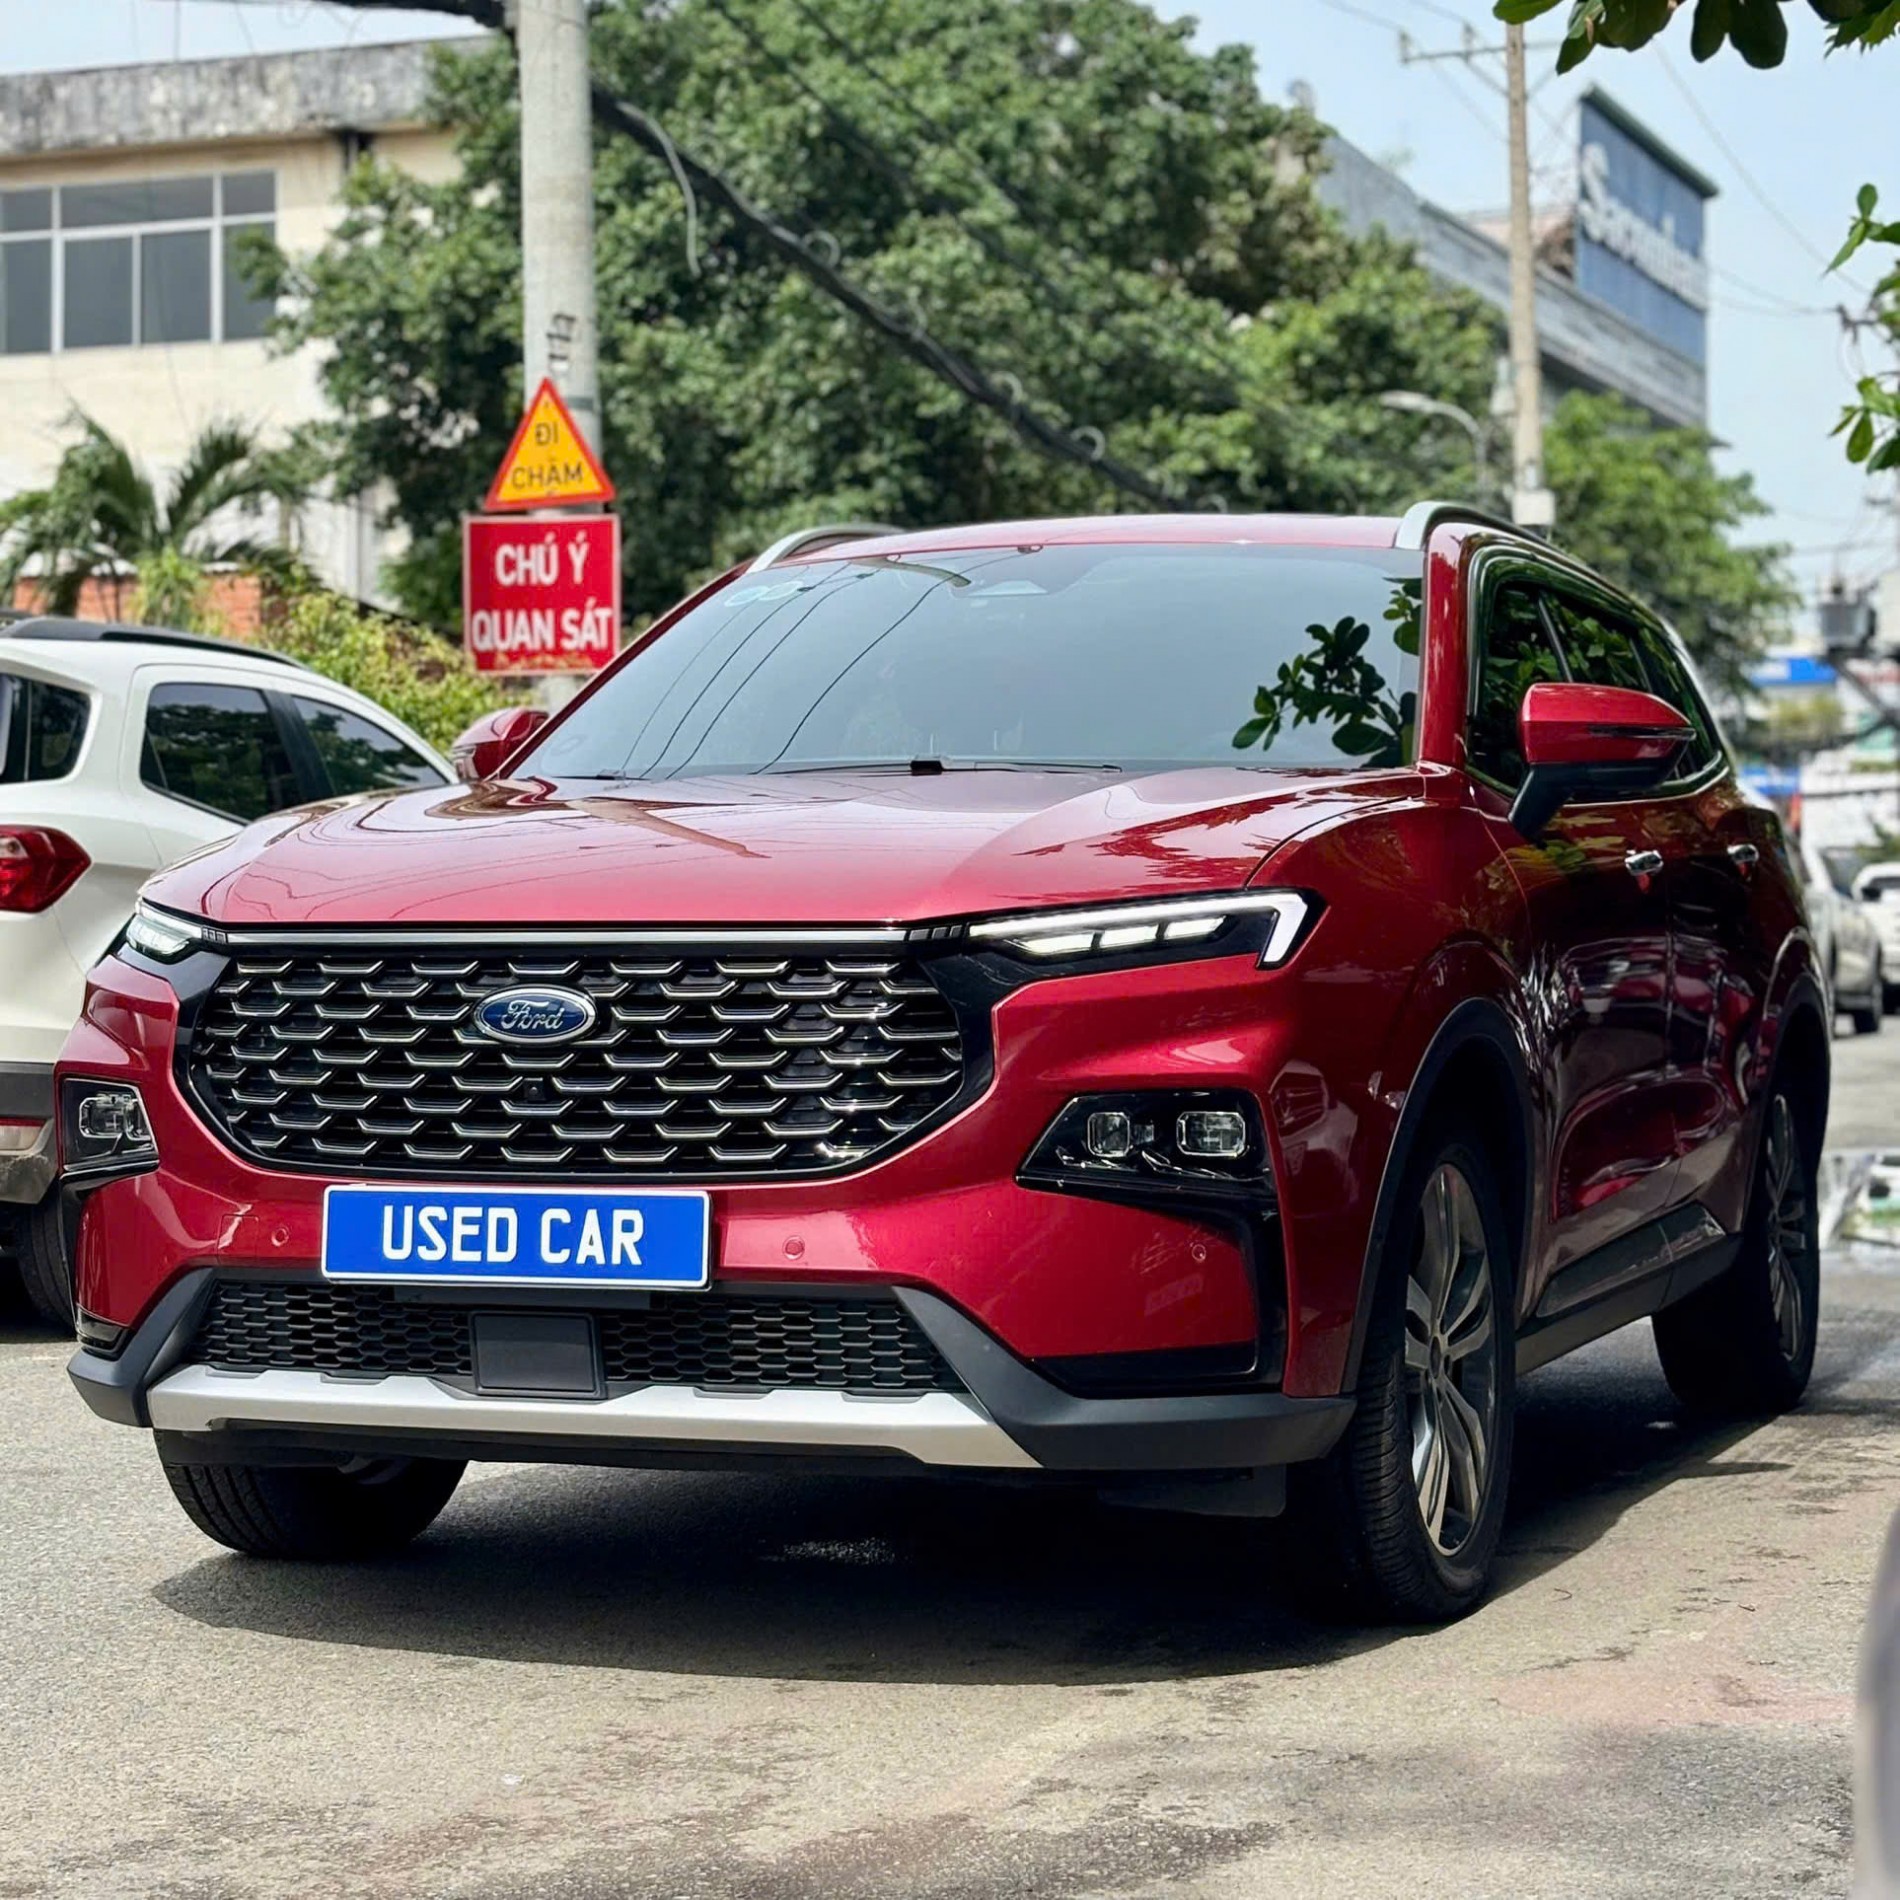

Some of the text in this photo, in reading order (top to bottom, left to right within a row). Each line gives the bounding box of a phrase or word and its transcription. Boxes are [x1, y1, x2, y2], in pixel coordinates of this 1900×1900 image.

[535, 421, 559, 446] ĐI
[495, 530, 590, 587] CHÚ Ý
[472, 596, 612, 652] QUAN SÁT
[500, 999, 565, 1030] Ford
[382, 1205, 644, 1265] USED CAR
